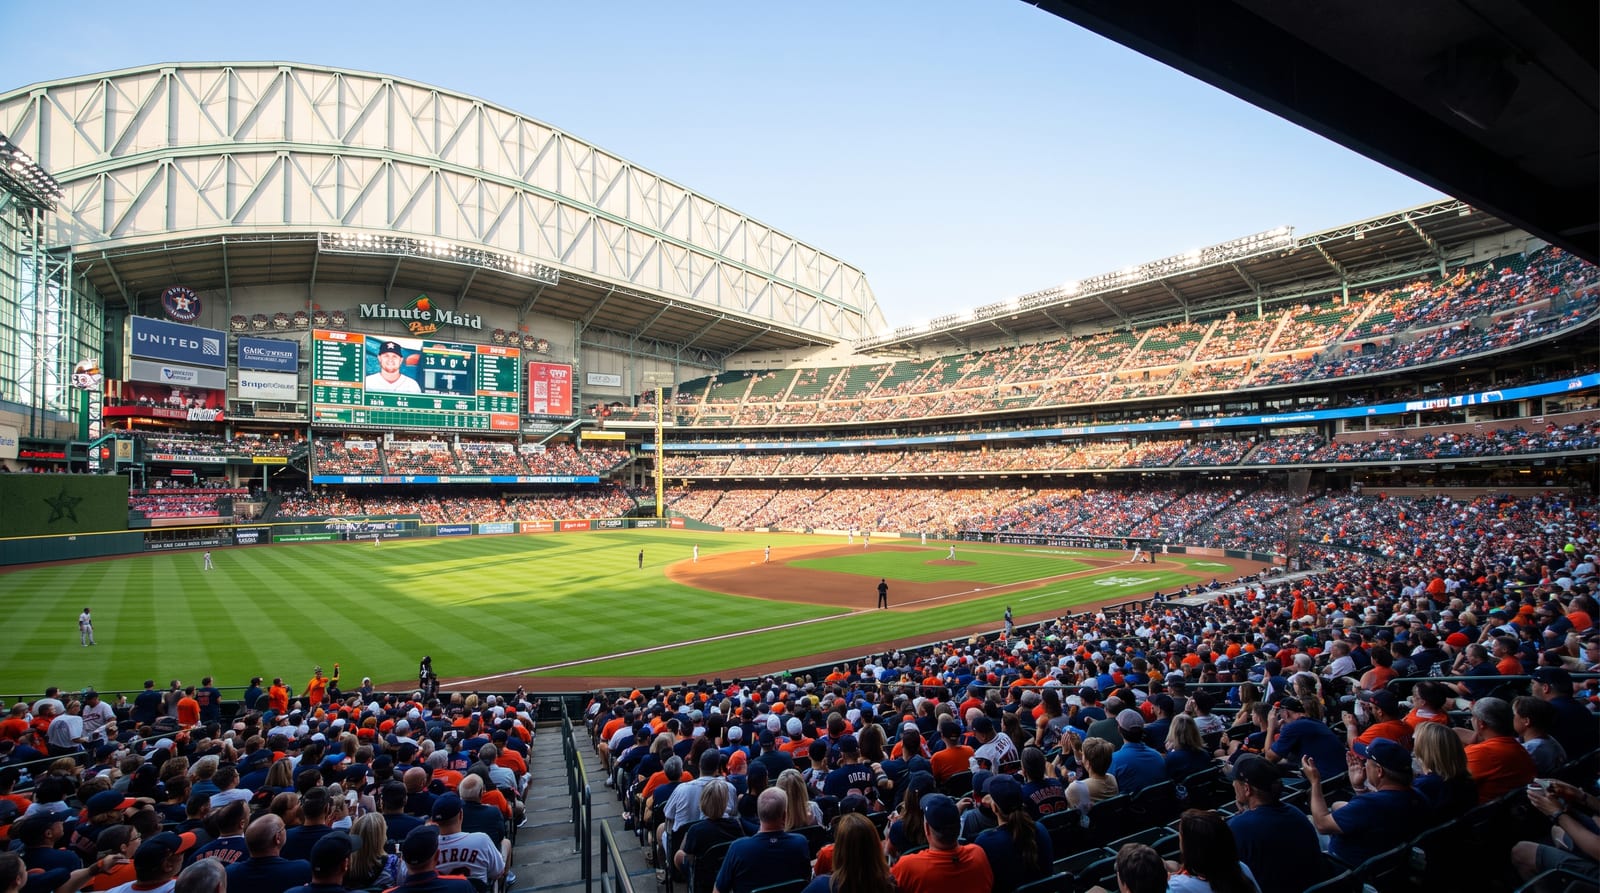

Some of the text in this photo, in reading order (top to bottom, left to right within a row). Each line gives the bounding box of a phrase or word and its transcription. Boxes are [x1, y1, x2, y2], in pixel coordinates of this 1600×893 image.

[359, 303, 482, 330] Minute Maid
[137, 332, 199, 349] UNITED
